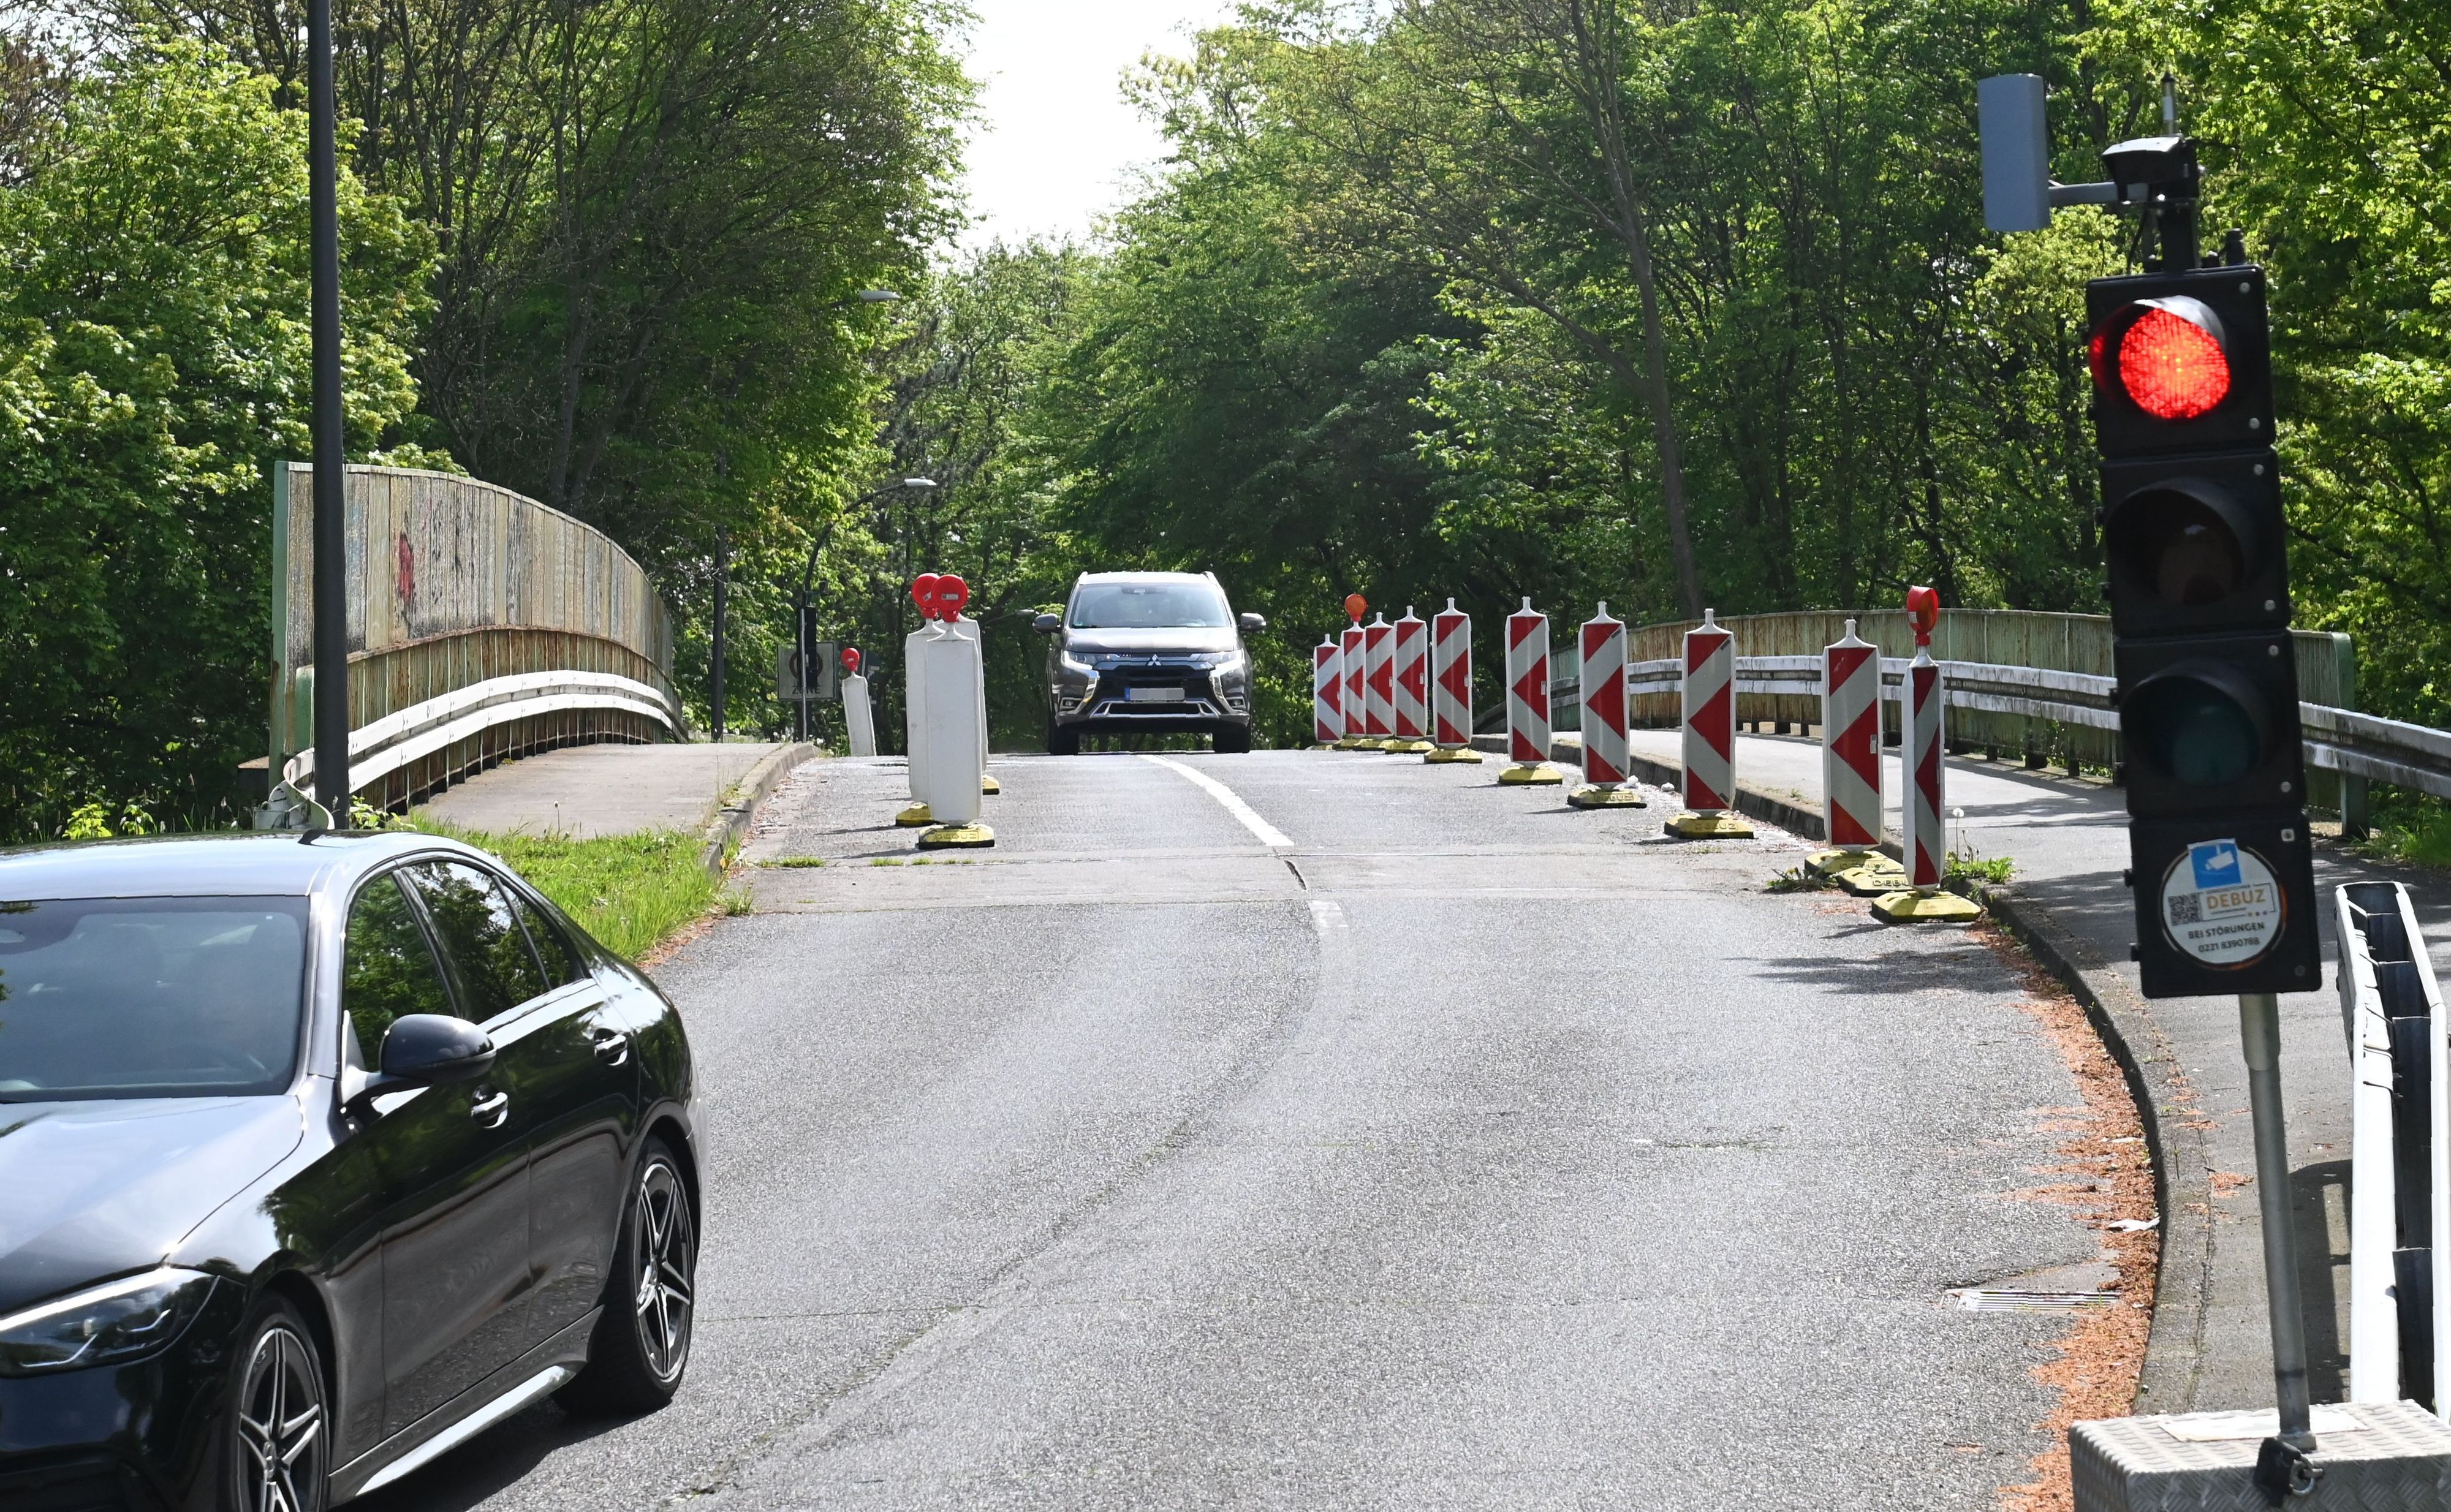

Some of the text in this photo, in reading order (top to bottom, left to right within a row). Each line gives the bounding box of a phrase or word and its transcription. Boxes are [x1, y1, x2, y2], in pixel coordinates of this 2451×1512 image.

[2207, 888, 2266, 909] DEBUZ
[2188, 921, 2265, 939] BEI STÖRUNGEN
[2197, 942, 2219, 952] 0221
